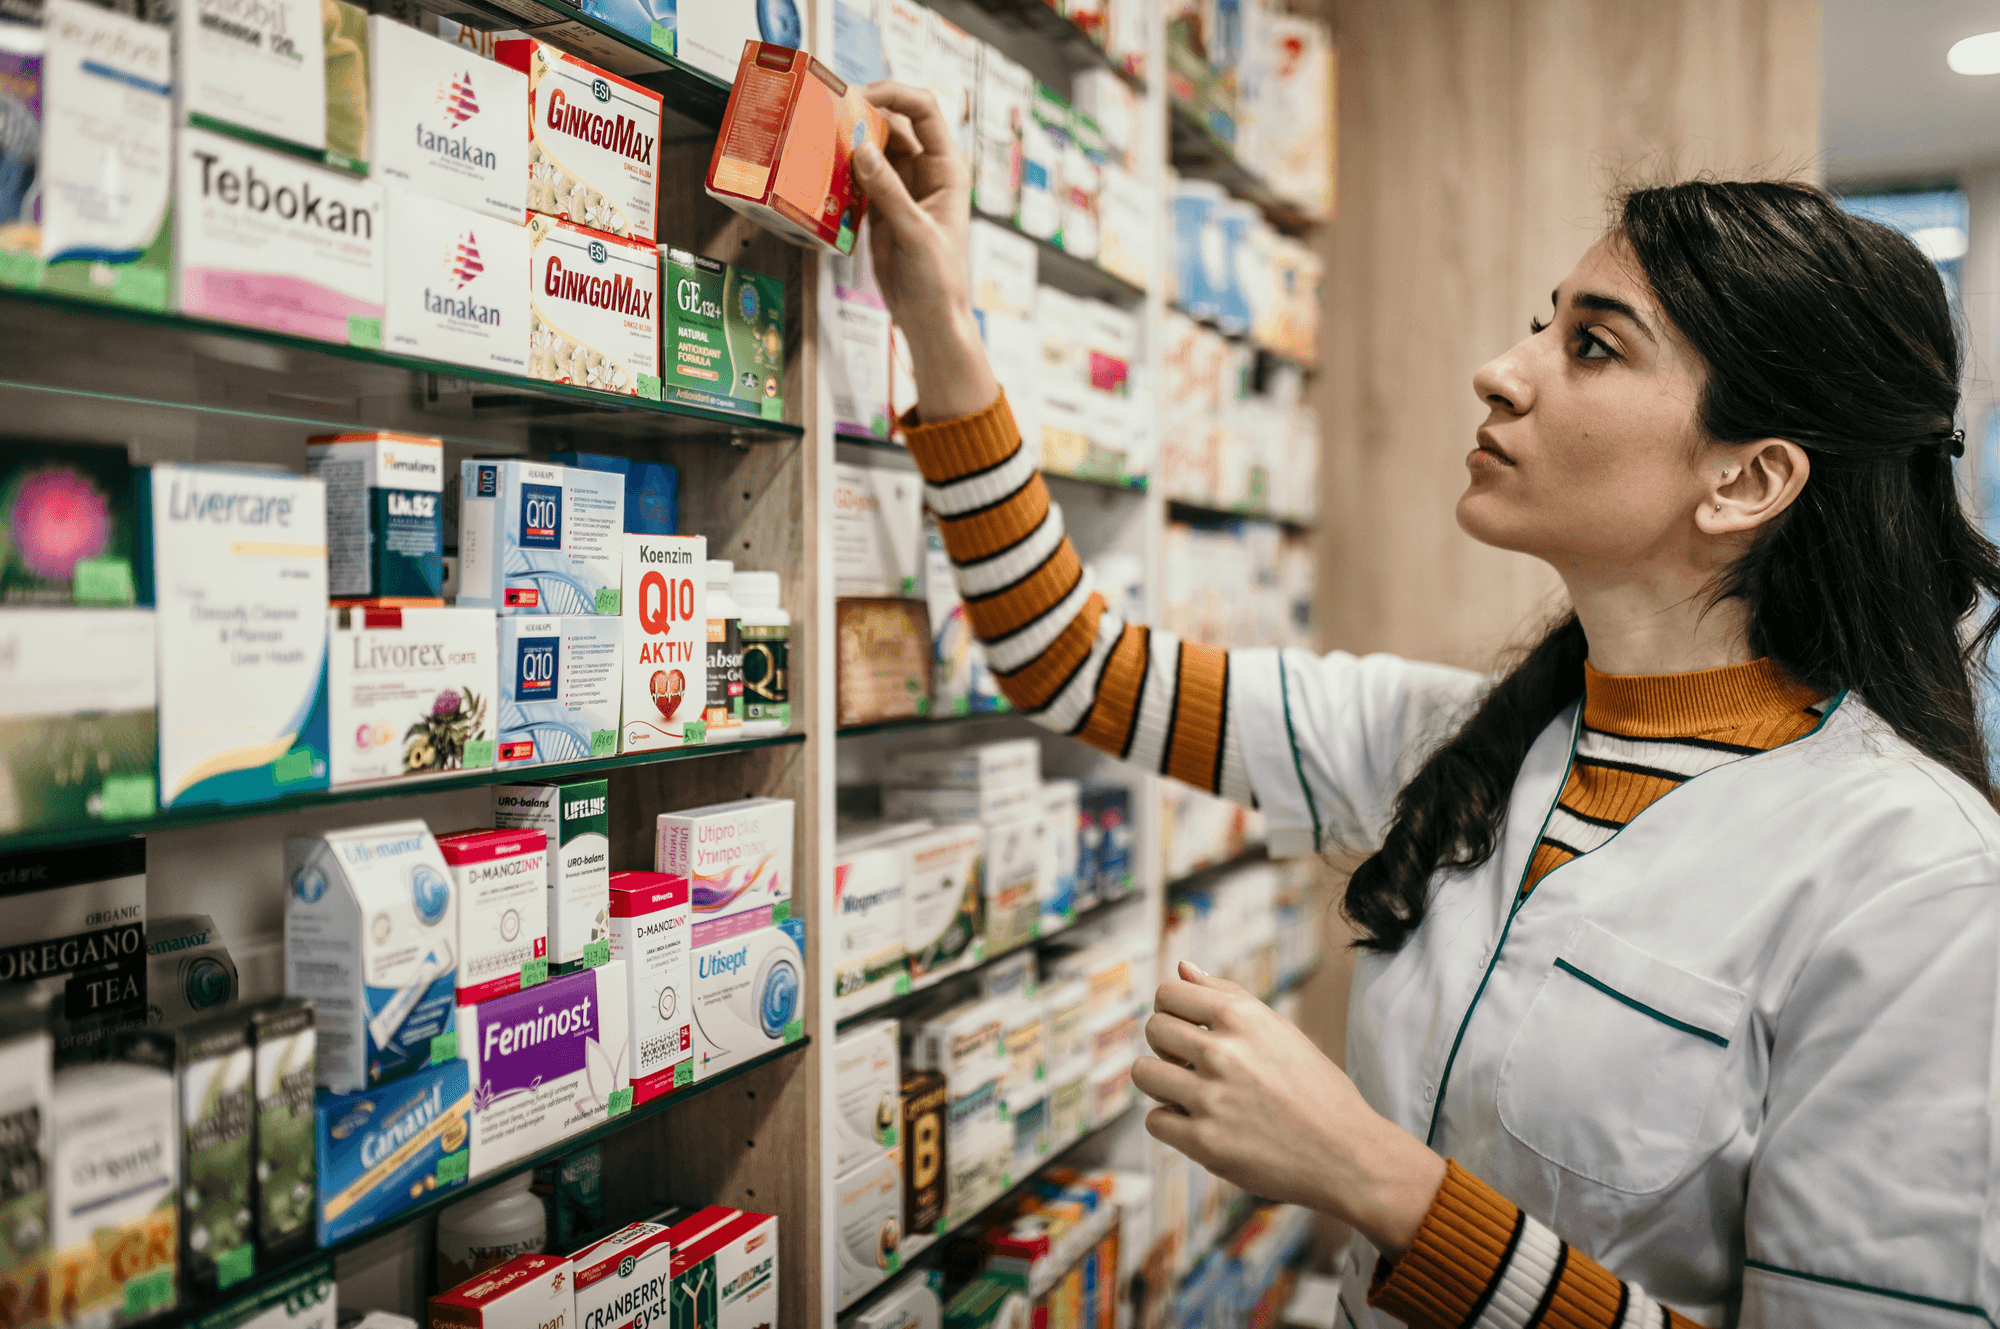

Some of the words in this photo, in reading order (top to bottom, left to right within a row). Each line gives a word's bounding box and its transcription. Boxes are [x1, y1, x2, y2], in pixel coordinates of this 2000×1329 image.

[594, 81, 609, 104] ESI
[416, 122, 497, 171] tanakan
[624, 162, 638, 174] GINKGO
[193, 150, 372, 239] Tebokan
[590, 243, 606, 262] ESI
[424, 288, 500, 327] tanakan
[678, 326, 709, 342] NATURAL
[677, 351, 711, 368] FORMULA
[678, 341, 721, 359] ANTIOXIDANT
[526, 500, 556, 529] Q10
[640, 545, 693, 564] Koenzim
[639, 570, 694, 636] Q10
[353, 635, 445, 669] Livorex
[448, 652, 477, 665] FORTE
[639, 641, 693, 664] AKTIV
[523, 652, 553, 681] Q10
[498, 796, 549, 808] URO-balans
[564, 796, 606, 821] LIFELINE
[680, 827, 689, 863] Utipro
[698, 823, 735, 844] Utipro
[670, 827, 679, 867] Утипро
[697, 846, 741, 867] Утипро
[468, 857, 540, 884] D-MANOZINN
[567, 853, 605, 868] URO-balans
[0, 864, 48, 885] otanic
[86, 904, 140, 926] ORGANIC
[637, 916, 685, 938] D-MANOZINN
[0, 928, 140, 980] OREGANO
[147, 929, 207, 957] emanoz
[699, 944, 747, 979] Utisept
[86, 973, 139, 1008] TEA
[484, 996, 592, 1062] Feminost
[508, 1098, 535, 1113] normalnoj
[555, 1081, 579, 1093] urinarnog
[530, 1104, 546, 1115] smislu
[570, 1108, 594, 1124] obloženih
[505, 1126, 515, 1136] nad
[516, 1114, 545, 1132] mokrenjem
[913, 1111, 940, 1190] B
[620, 1258, 634, 1277] ESI
[585, 1272, 667, 1329] CRANBERRY
